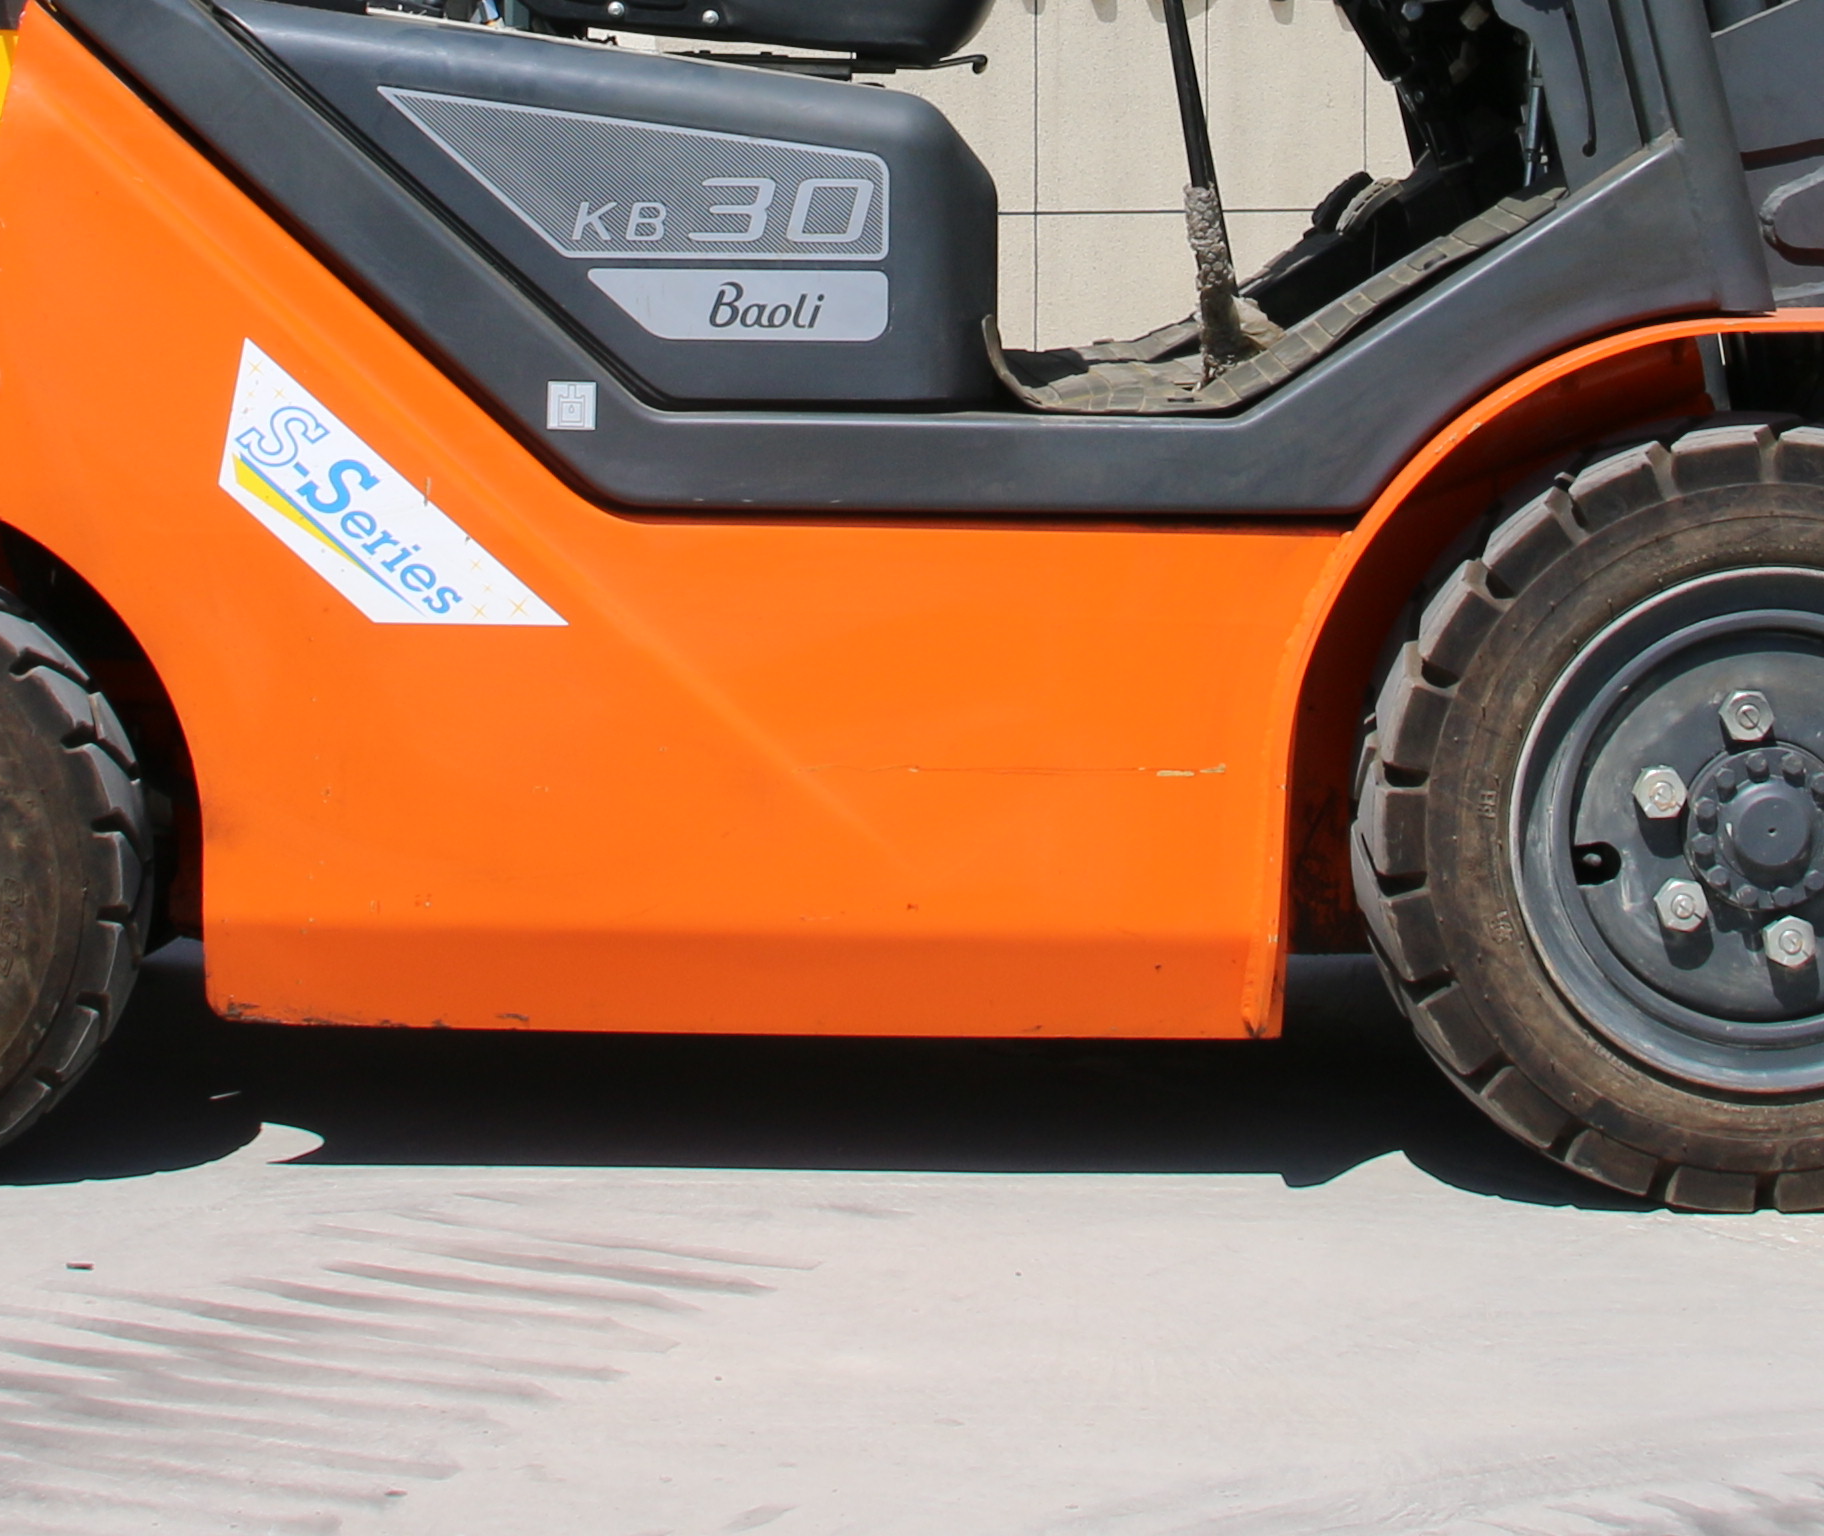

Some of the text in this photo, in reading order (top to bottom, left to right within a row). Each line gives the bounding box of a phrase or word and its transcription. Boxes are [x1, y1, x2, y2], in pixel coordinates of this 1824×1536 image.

[571, 177, 875, 244] KB 30
[708, 280, 825, 331] Baoli
[234, 405, 465, 615] S-Series
